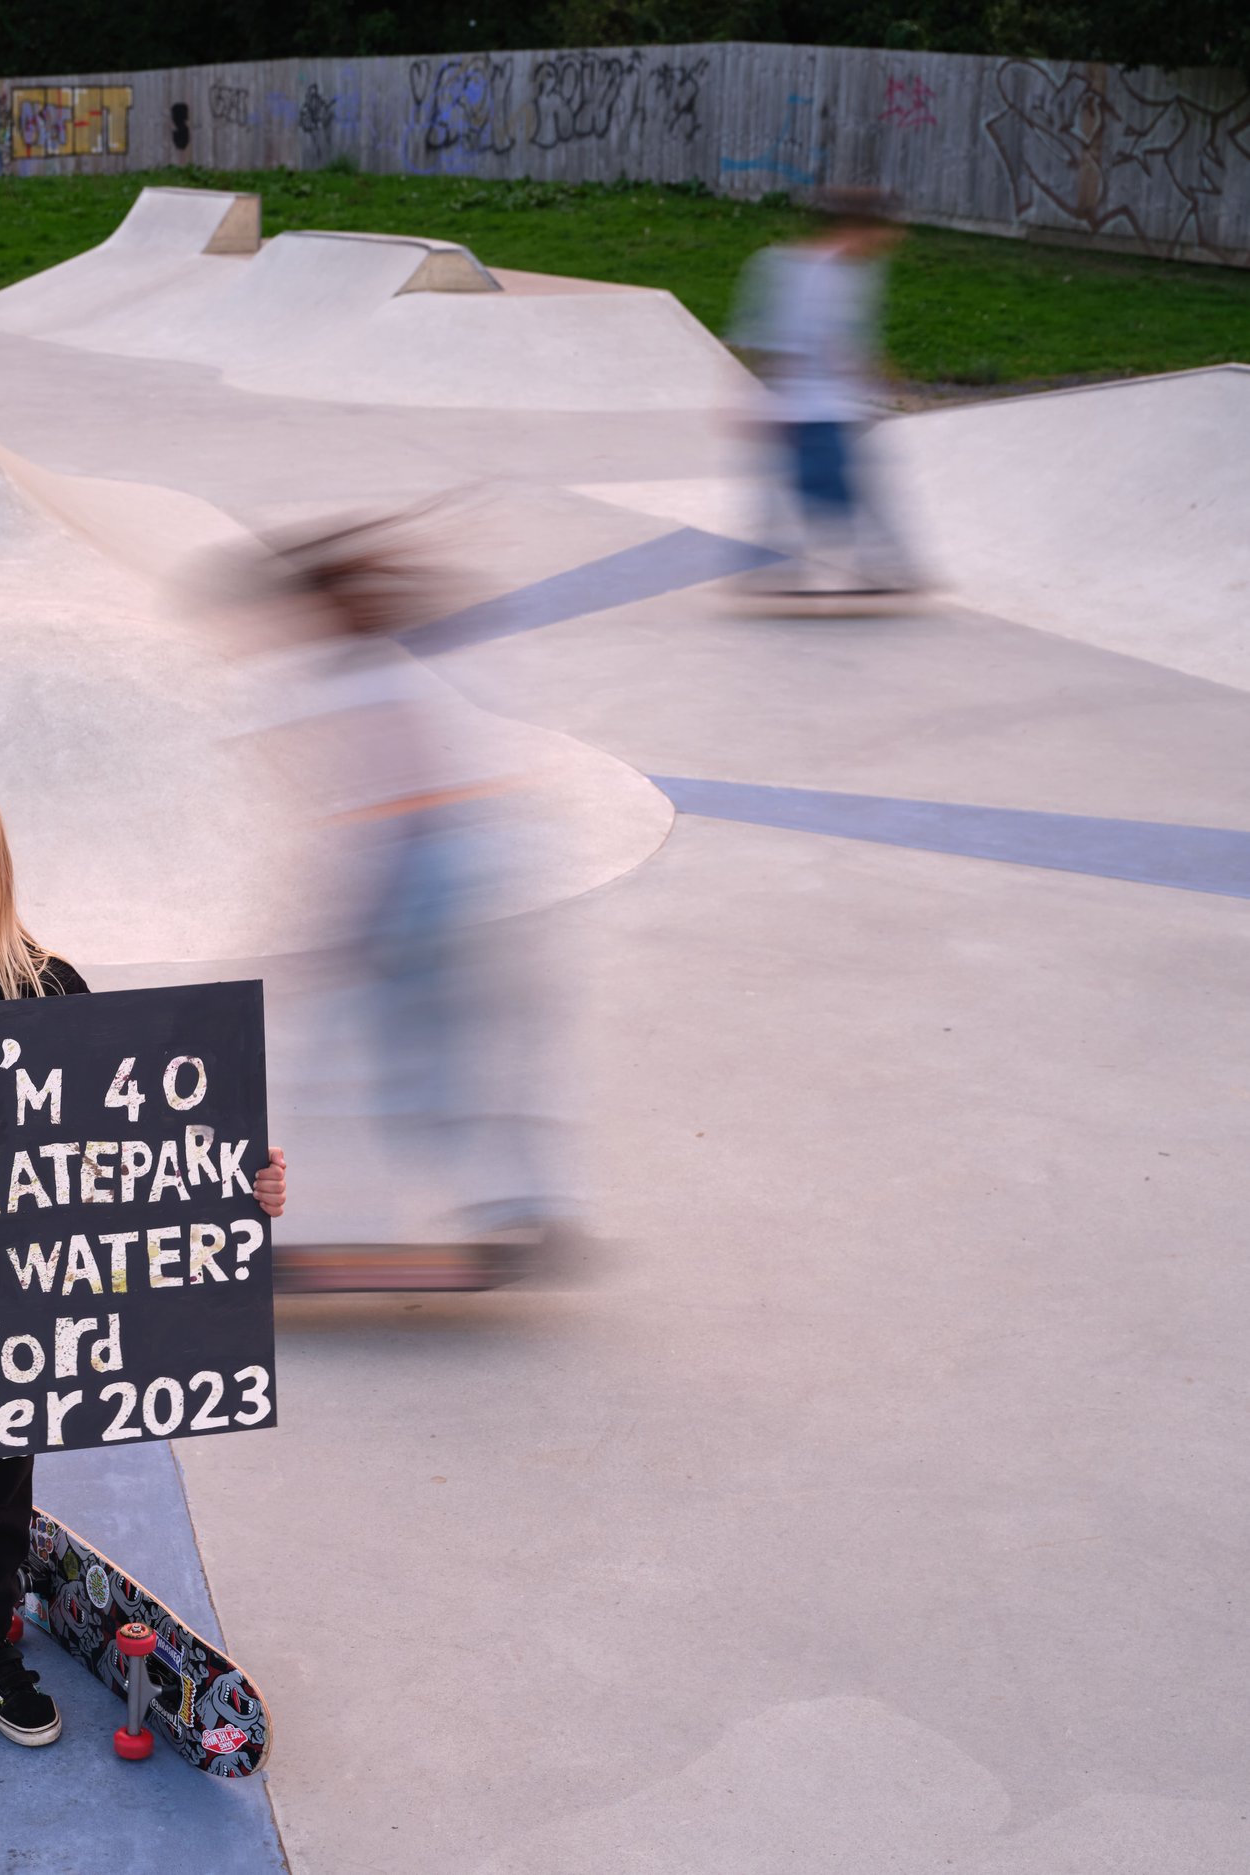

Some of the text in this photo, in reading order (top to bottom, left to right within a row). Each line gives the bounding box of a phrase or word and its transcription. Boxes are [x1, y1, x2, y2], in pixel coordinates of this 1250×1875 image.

[104, 1056, 207, 1122] 40
[6, 1219, 264, 1297] WATER?
[99, 1365, 271, 1441] 2023
[219, 1741, 236, 1751] VANS
